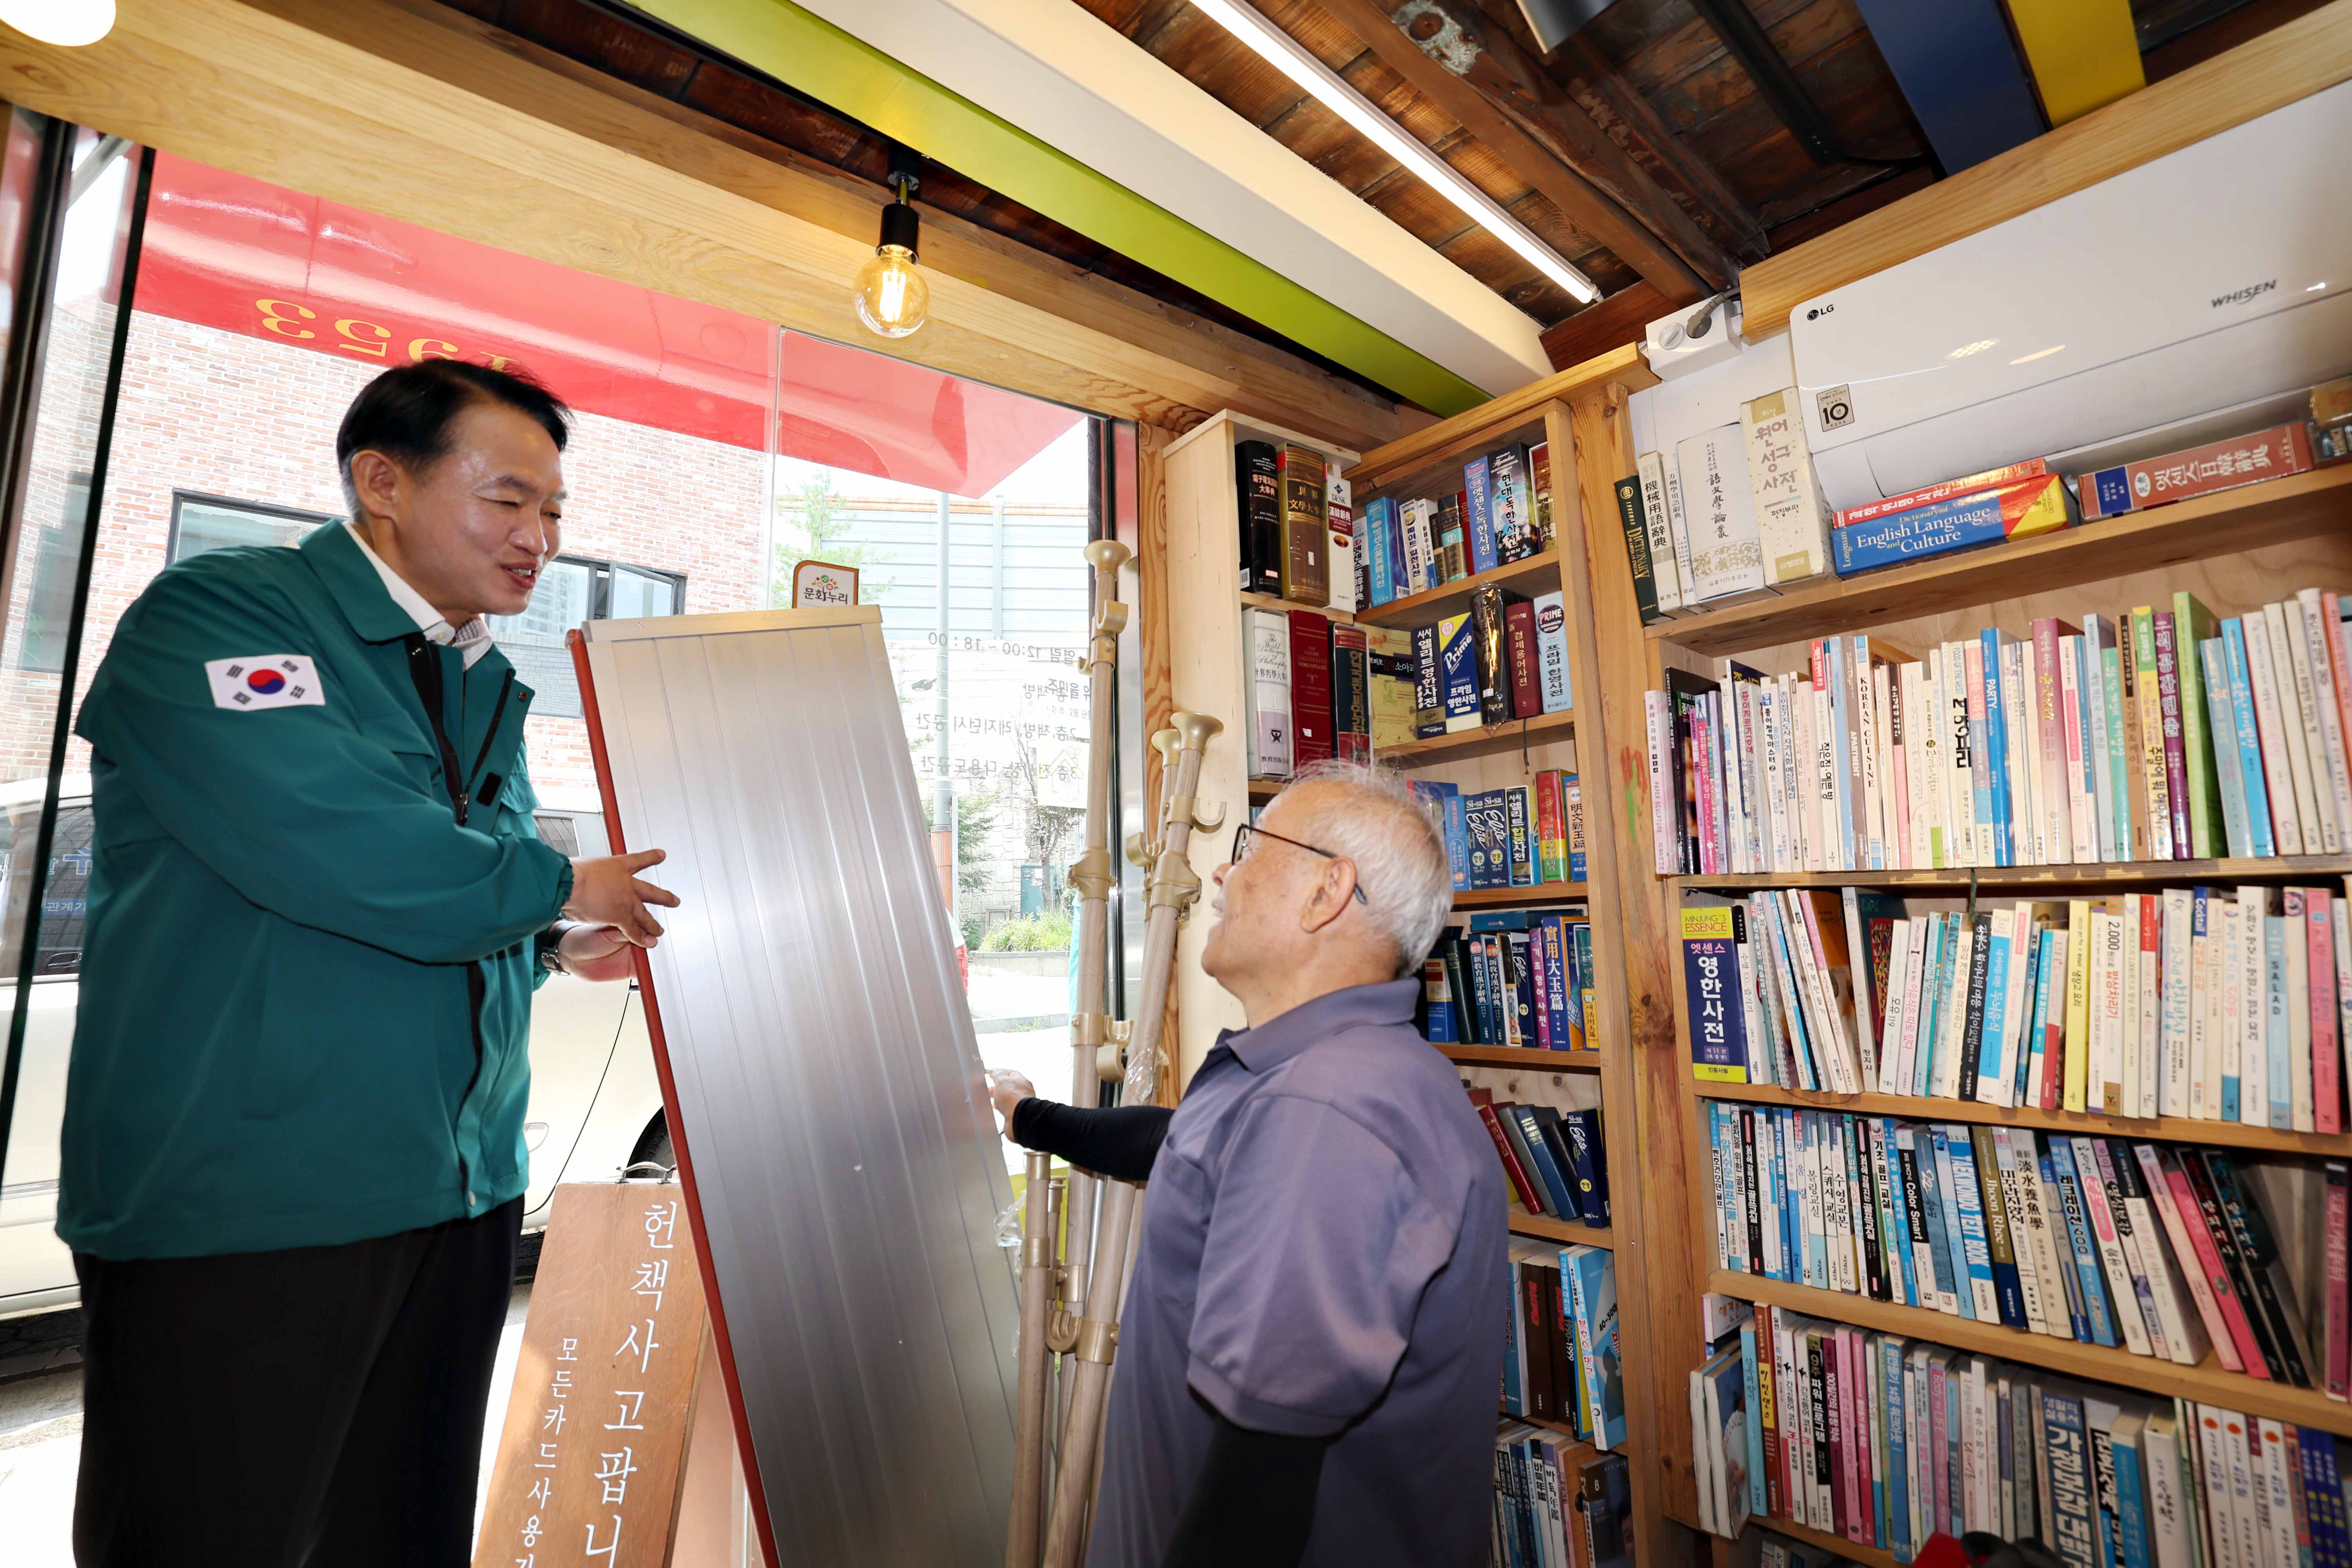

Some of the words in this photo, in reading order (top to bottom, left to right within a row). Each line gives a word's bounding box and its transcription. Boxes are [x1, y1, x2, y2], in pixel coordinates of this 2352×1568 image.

[2211, 279, 2276, 309] WHISEN
[1821, 305, 1834, 315] LG
[1823, 403, 1849, 424] 10
[1755, 419, 1788, 447] 원어
[1761, 445, 1791, 473] 성구
[1763, 470, 1797, 494] 사전
[1332, 494, 1346, 505] DESK
[1501, 473, 1518, 550] 현대독한사전
[1472, 486, 1491, 556] 엣센스독한사전
[1857, 524, 1911, 549] English
[1915, 508, 1991, 534] Language
[1900, 509, 1938, 524] Dictionary
[1843, 531, 1853, 568] Longman
[1886, 539, 1900, 549] and
[1901, 531, 1962, 553] Culture
[804, 586, 848, 605] 문화누리
[1539, 608, 1563, 625] PRIME
[1417, 628, 1432, 639] 시사
[1443, 634, 1473, 669] Prime
[1514, 630, 1528, 686] 경제용어사전
[1546, 645, 1561, 666] 프라임
[1450, 684, 1472, 697] 프라임
[1548, 668, 1563, 697] 한영사전
[1985, 678, 1998, 709] PARTY
[1447, 694, 1477, 709] 영한사전
[1860, 677, 1870, 726] KOREAN
[1765, 708, 1777, 765] 종이접기마스터
[1850, 731, 1860, 777] APARTMENT
[1864, 730, 1874, 788] CUISINE
[2148, 747, 2164, 778] 주말에
[1685, 915, 1727, 923] MINJUNG'S
[1685, 922, 1727, 933] ESSENCE
[2195, 898, 2206, 933] Cocktail
[1690, 943, 1726, 955] 엣센스
[1532, 948, 1546, 1027] 기초영어사전
[1698, 956, 1725, 1044] 영한사전
[2270, 960, 2281, 1016] SALAD
[1888, 998, 1900, 1014] 모유
[1874, 1140, 1886, 1161] 기초
[1735, 1175, 1744, 1196] 골프
[1822, 1165, 1835, 1199] 스쿼시
[1878, 1164, 1889, 1185] 골프
[1950, 1155, 1981, 1212] TAEKWONDO
[1807, 1170, 1820, 1218] 볼링교실
[1881, 1188, 1891, 1209] 교실
[1985, 1178, 2000, 1210] Jhoon
[2000, 1170, 2025, 1225] 미꾸라지양식
[2060, 1175, 2083, 1226] 레크레이션
[1825, 1202, 1837, 1223] 교실
[1905, 1181, 1917, 1208] Color
[1911, 1209, 1924, 1241] Smart
[1961, 1213, 1985, 1238] TEXT
[1992, 1211, 2004, 1245] Rhee
[1964, 1238, 1990, 1268] BOOK
[1594, 1479, 1600, 1492] 8
